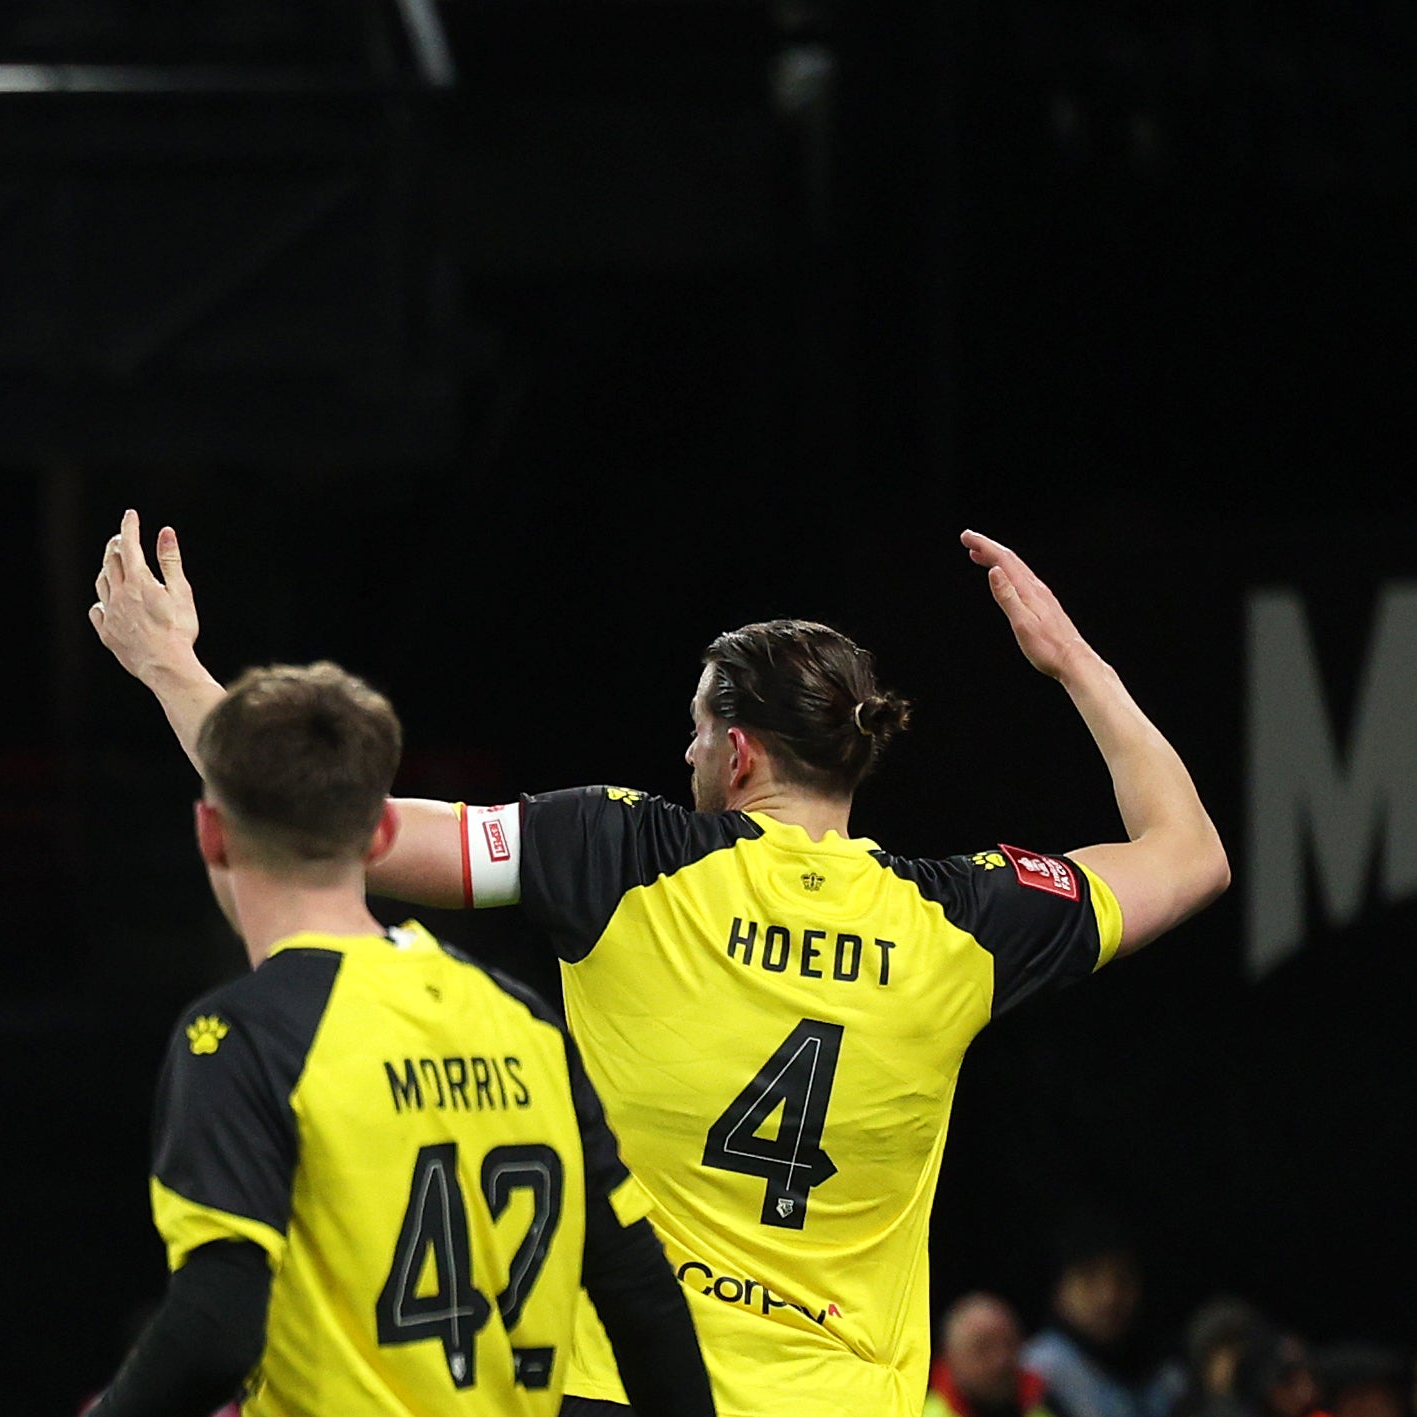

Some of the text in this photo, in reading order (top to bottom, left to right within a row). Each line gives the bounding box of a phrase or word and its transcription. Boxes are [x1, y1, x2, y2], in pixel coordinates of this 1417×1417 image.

[727, 917, 896, 987] HOEDT
[383, 1056, 532, 1115] MORRIS
[701, 1017, 838, 1231] 4
[375, 1142, 566, 1391] 42
